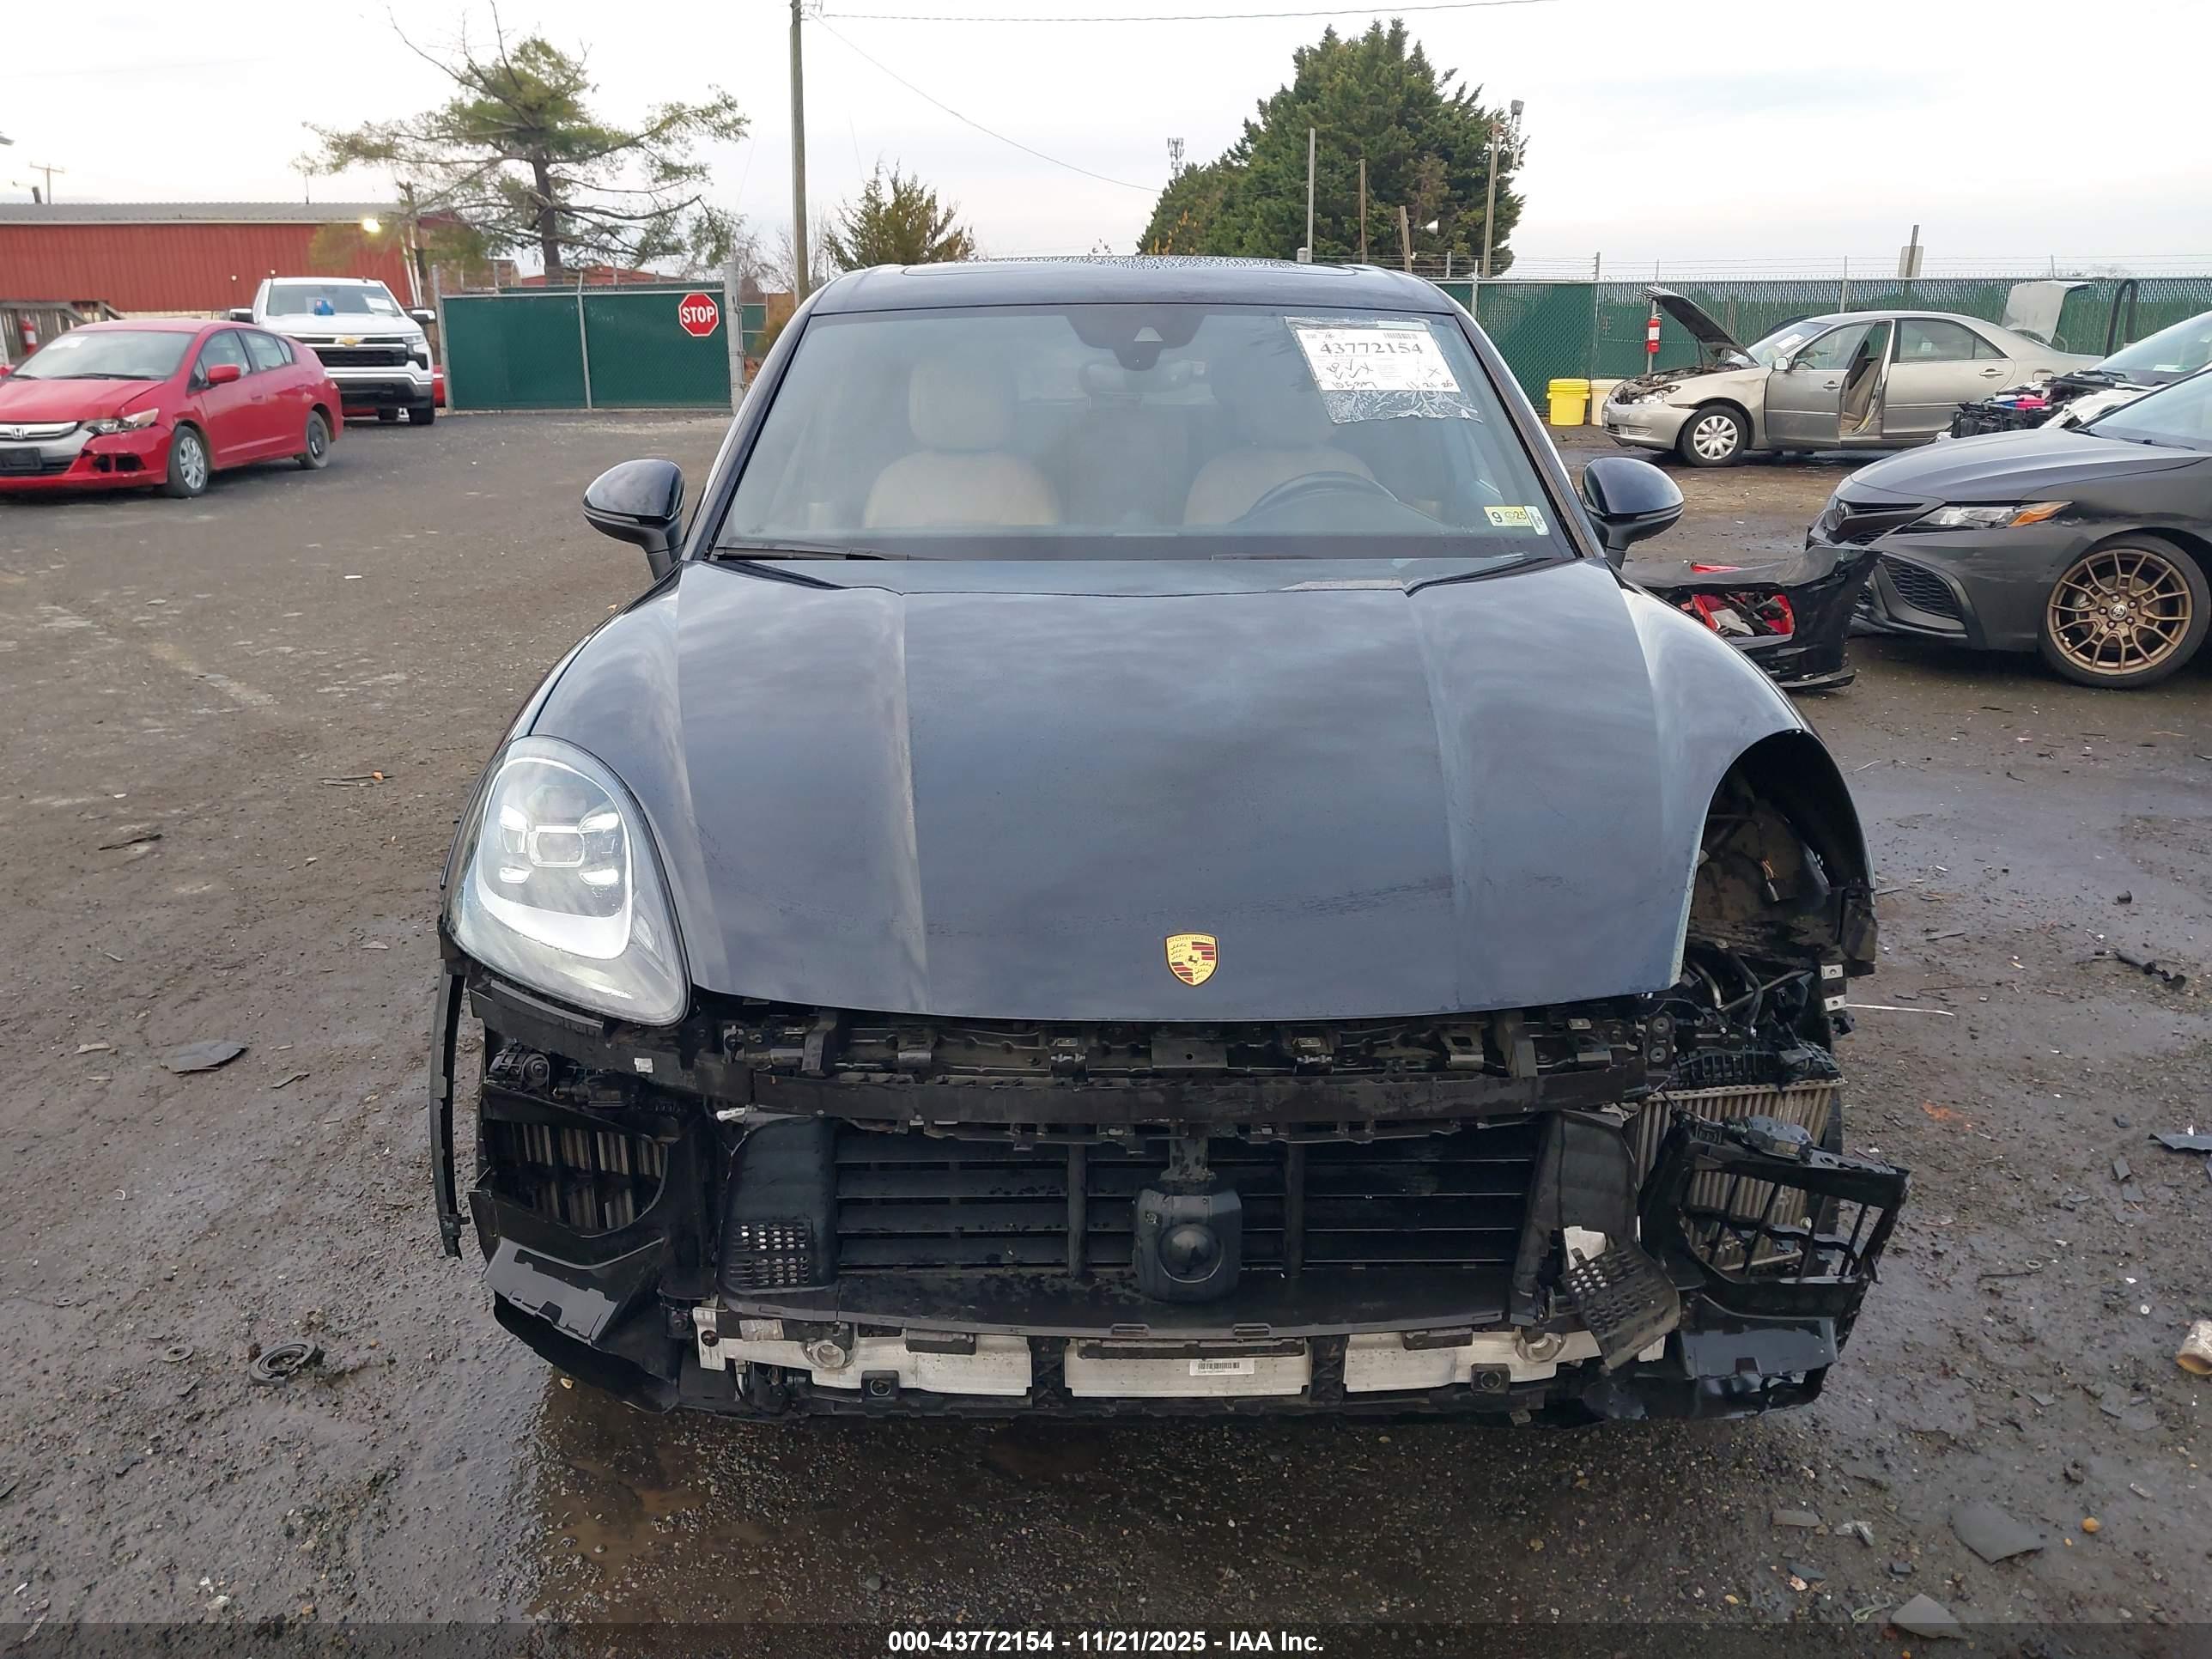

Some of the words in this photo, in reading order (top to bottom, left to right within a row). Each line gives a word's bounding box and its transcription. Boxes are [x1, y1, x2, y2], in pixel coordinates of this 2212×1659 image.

[682, 306, 715, 324] STOP
[1320, 343, 1424, 355] 43772154
[1492, 511, 1503, 523] 9
[1514, 510, 1527, 520] 25
